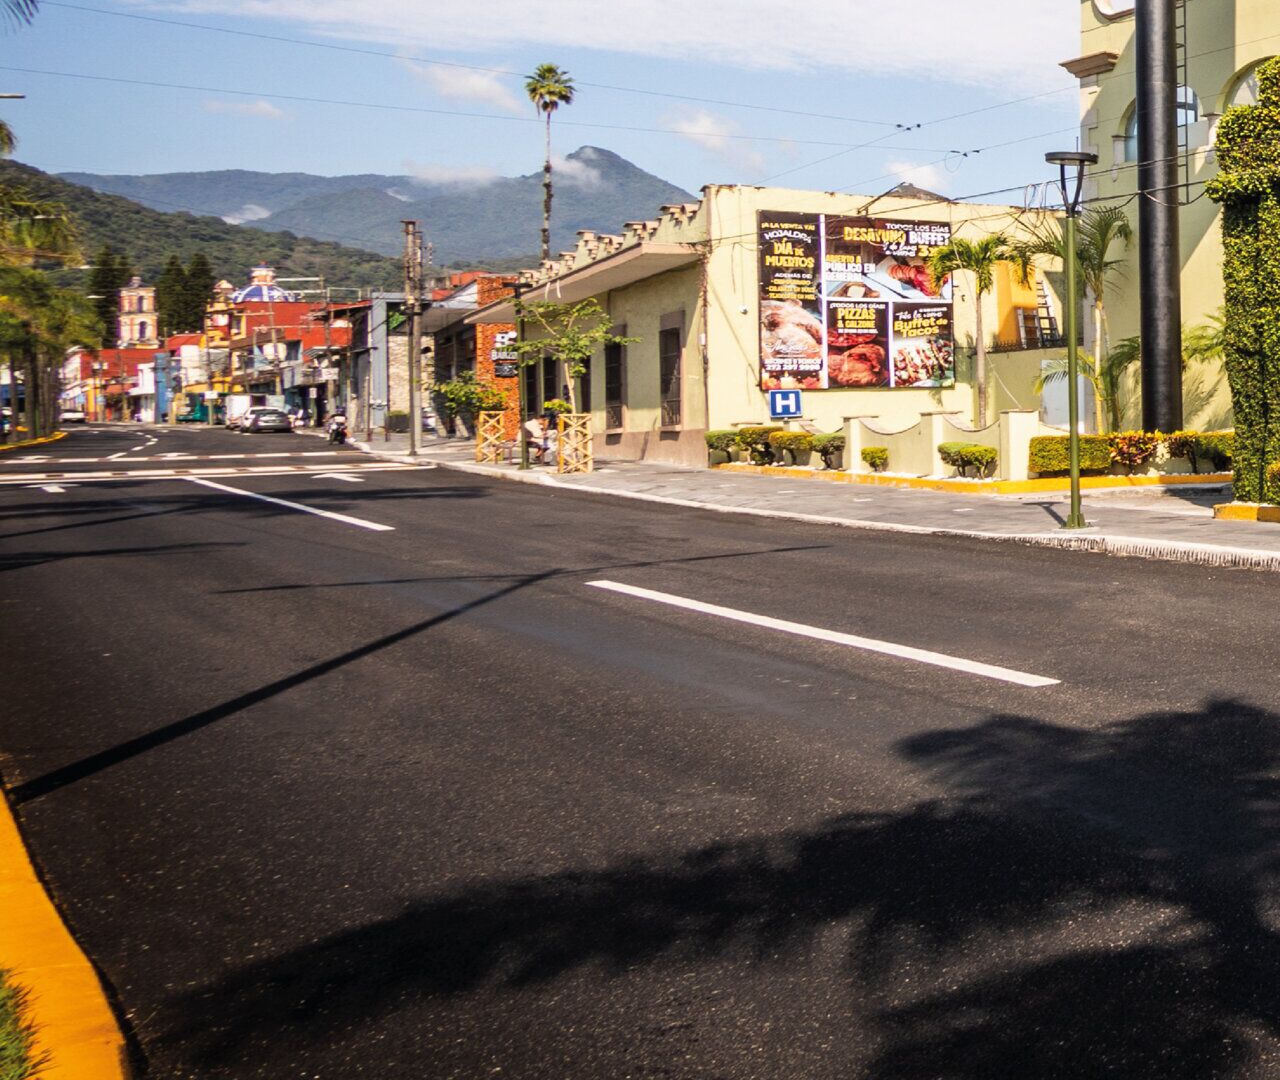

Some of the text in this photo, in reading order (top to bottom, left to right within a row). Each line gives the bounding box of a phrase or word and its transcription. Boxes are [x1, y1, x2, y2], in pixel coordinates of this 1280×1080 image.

[885, 223, 949, 233] TODOS LOS DÍAS
[843, 226, 951, 246] DESAYUNO BUFFET
[773, 237, 794, 255] DÍA
[765, 255, 815, 268] MUERTOS
[837, 308, 876, 320] PIZZAS
[894, 317, 937, 331] Buffet
[900, 326, 940, 338] Tacos
[775, 393, 796, 413] H
